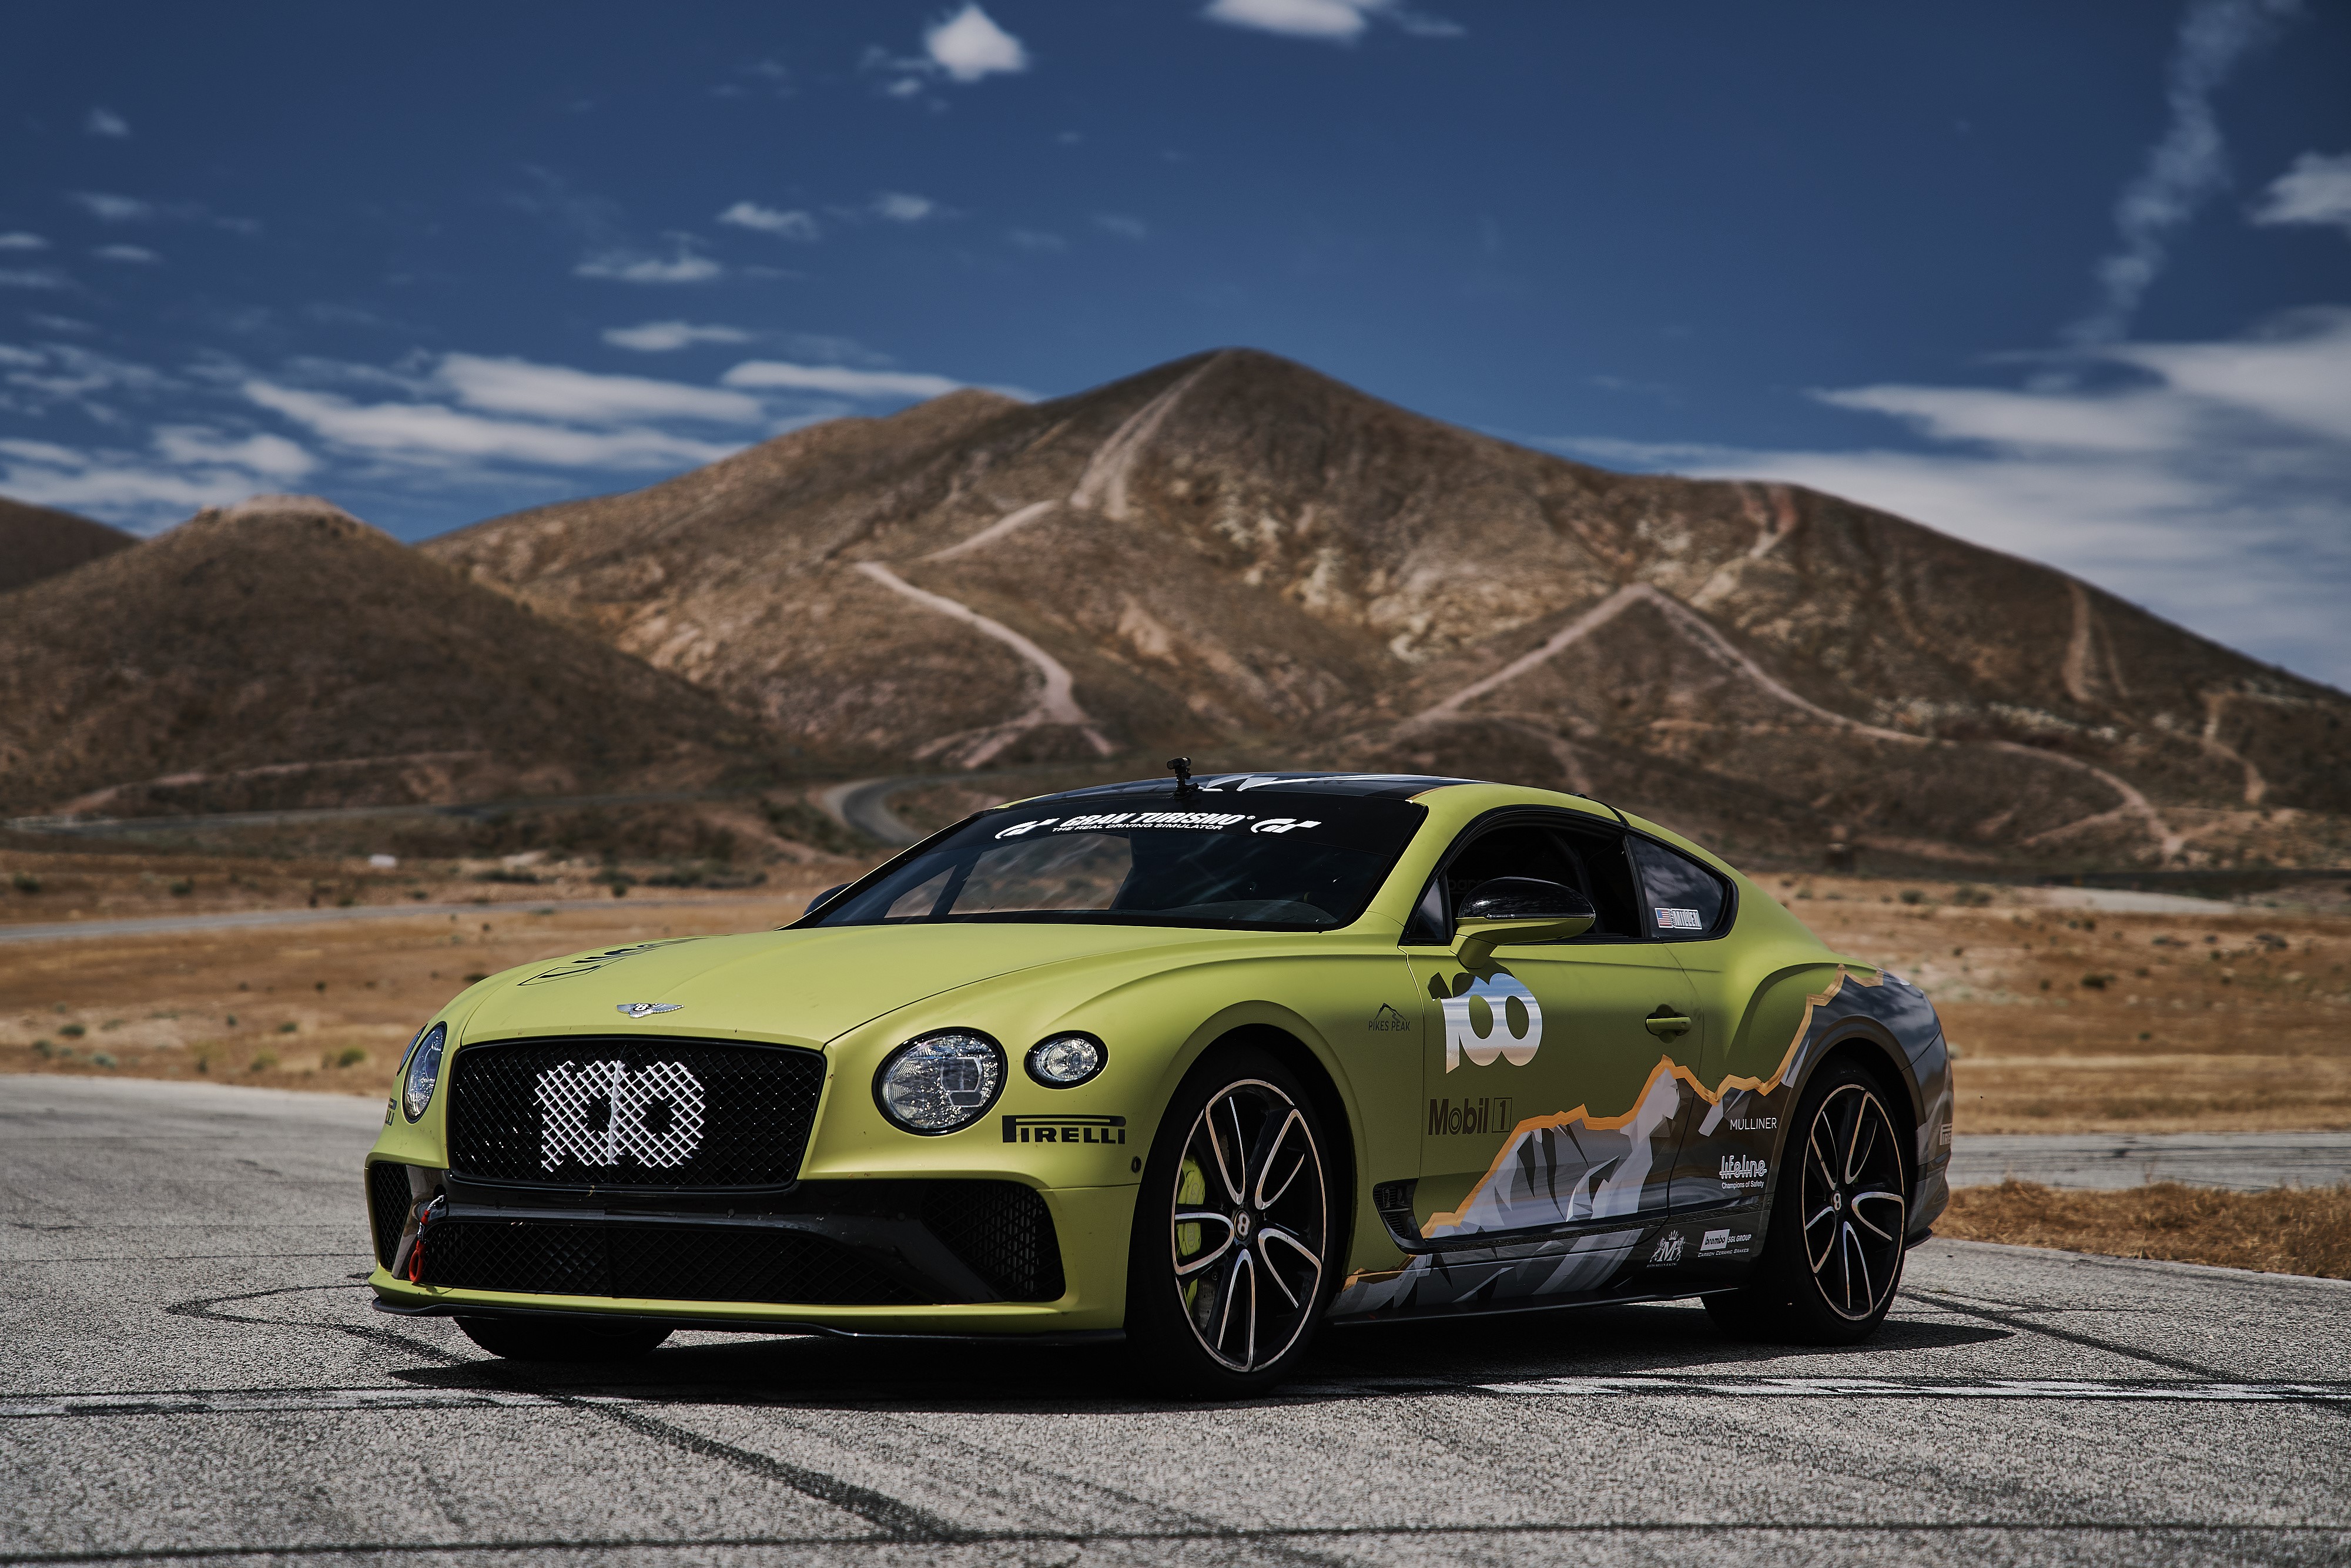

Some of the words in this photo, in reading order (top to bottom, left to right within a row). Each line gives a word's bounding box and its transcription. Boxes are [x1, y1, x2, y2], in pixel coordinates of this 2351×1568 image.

[1060, 813, 1137, 827] GRAN
[1672, 910, 1701, 927] MILLEN
[1368, 1020, 1389, 1031] PIKES
[1391, 1021, 1411, 1031] PEAK
[1428, 1097, 1489, 1135] Mobil
[1002, 1115, 1127, 1144] PIRELLI
[1730, 1117, 1777, 1130] MULLINER
[1719, 1154, 1767, 1180] lifeline
[1722, 1181, 1745, 1190] Champions
[1750, 1180, 1764, 1188] Safety
[1705, 1235, 1726, 1245] brembo
